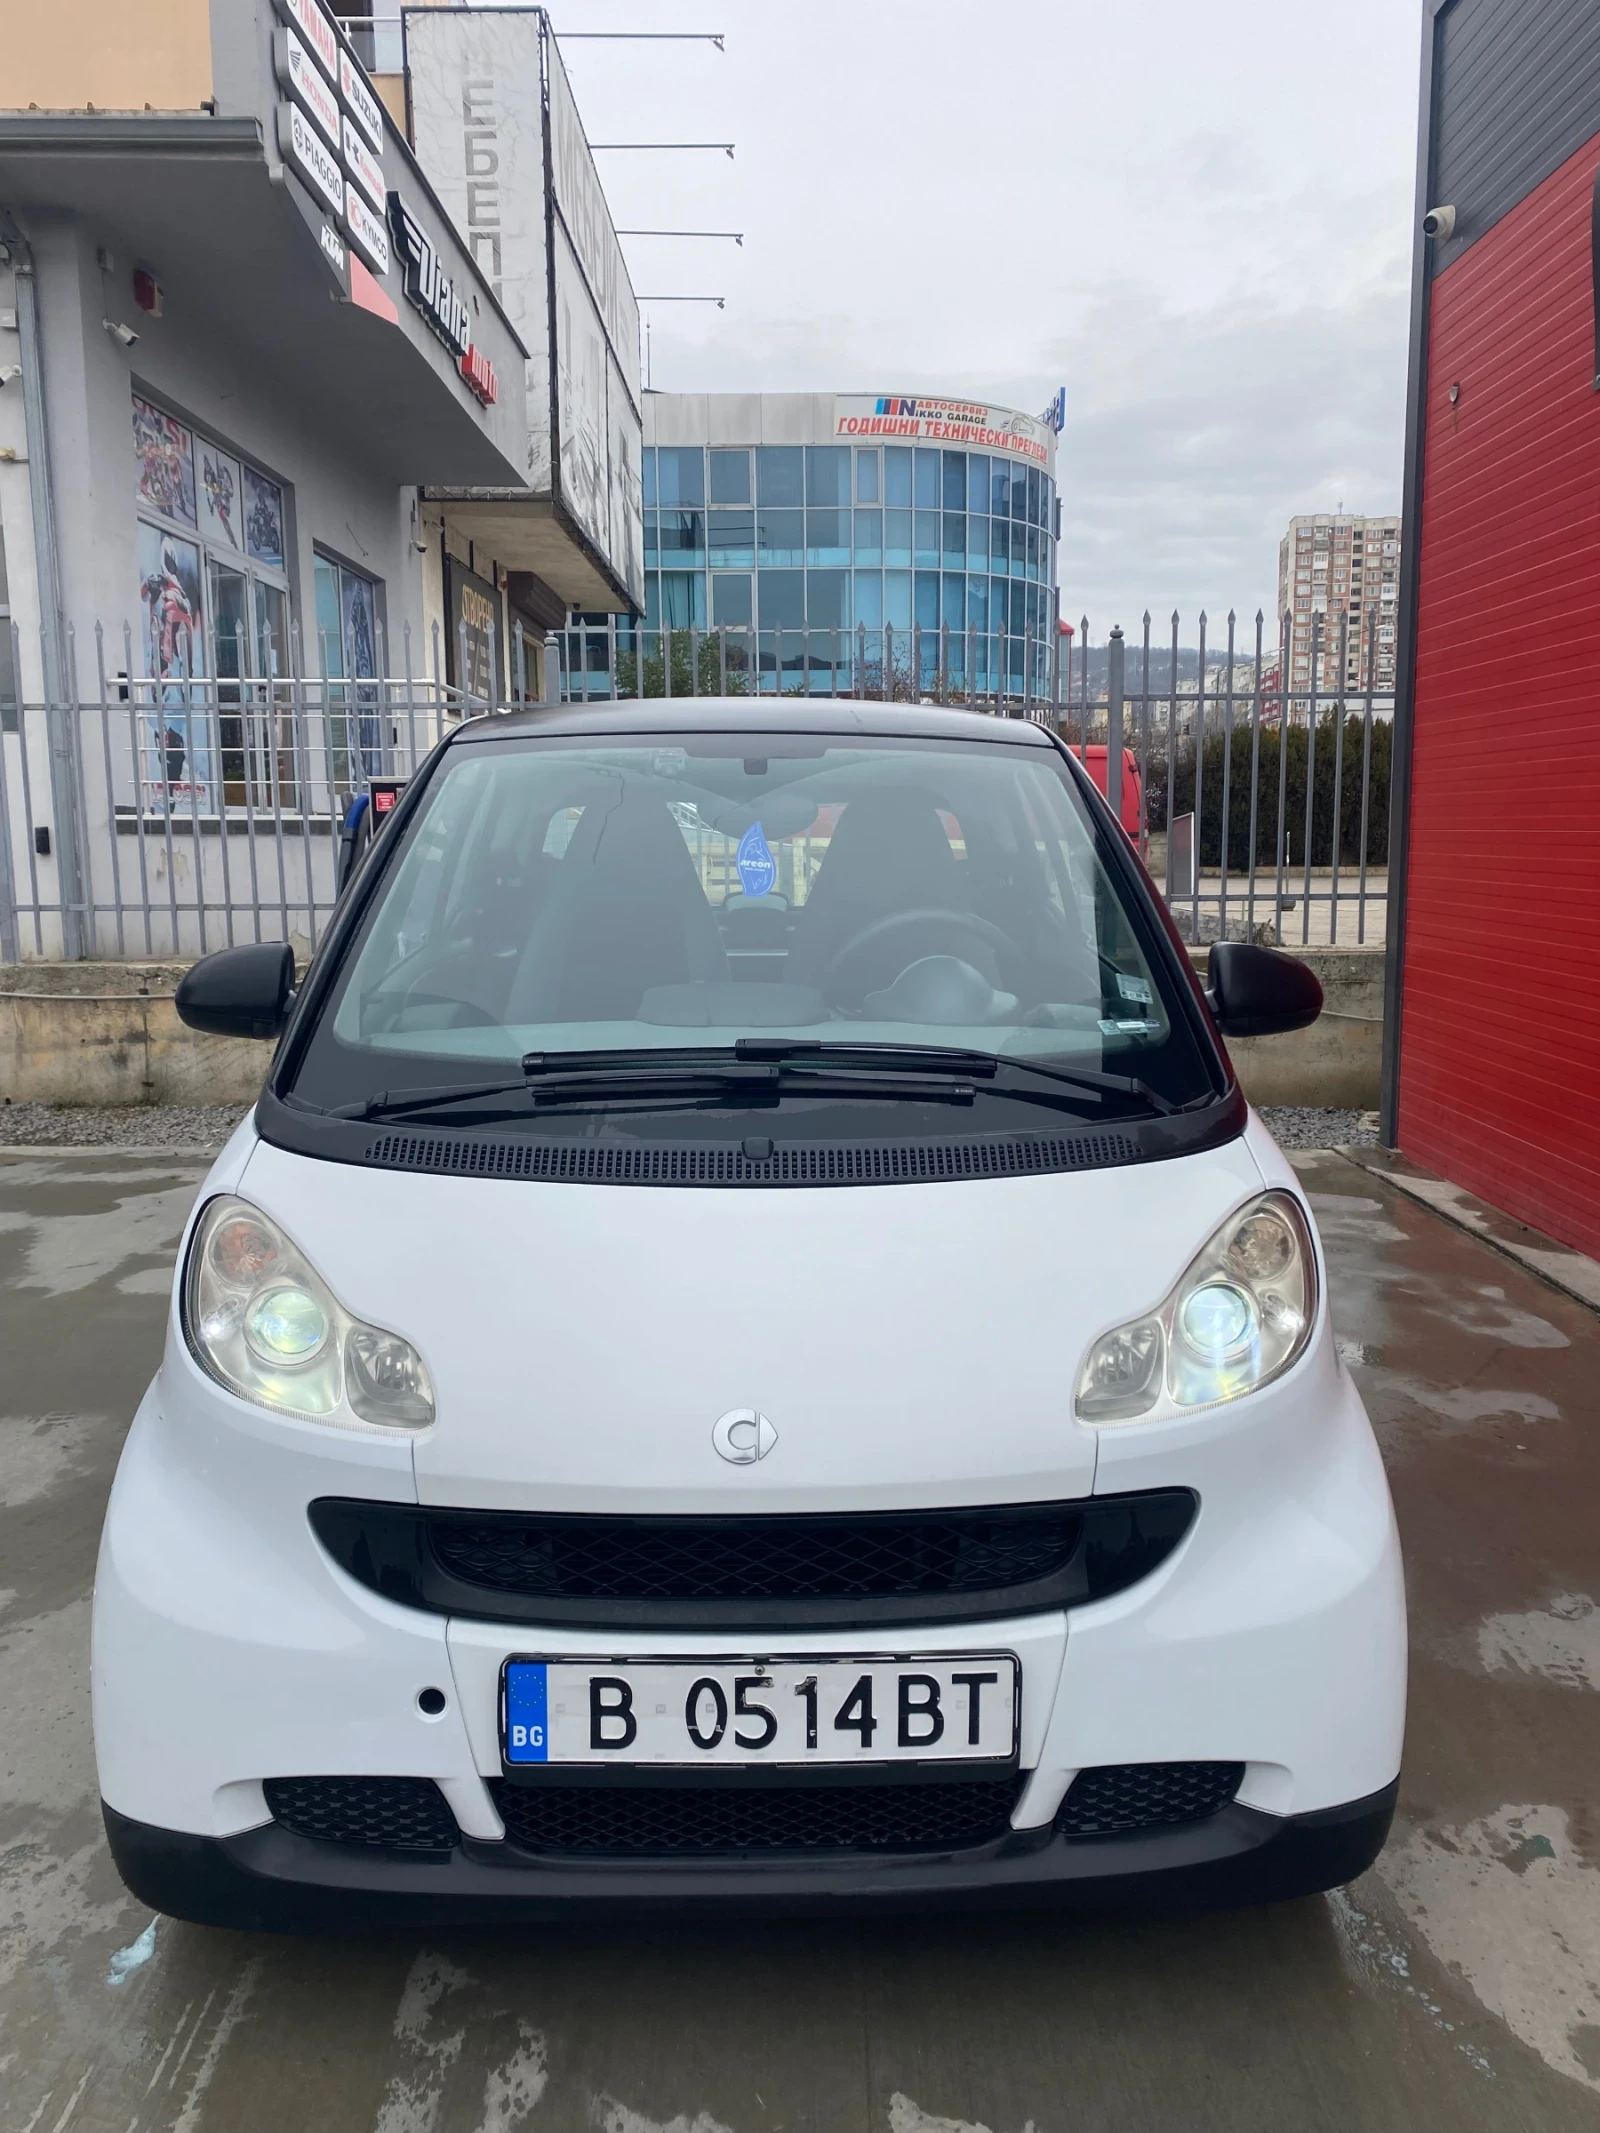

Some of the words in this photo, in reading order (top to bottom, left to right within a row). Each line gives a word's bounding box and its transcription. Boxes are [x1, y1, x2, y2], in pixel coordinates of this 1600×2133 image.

[301, 67, 338, 136] HONDA
[351, 79, 382, 142] SUZUKI
[304, 132, 342, 200] PIAGGIO
[320, 224, 344, 271] KTM
[361, 215, 387, 261] KYMCO
[408, 212, 471, 356] Diana
[917, 400, 989, 417] АВТОСЕРВИЗ
[947, 412, 988, 426] GARAGE
[837, 416, 921, 436] ГОДИШНИ
[924, 420, 1010, 448] ТЕХНИЧЕСКИ
[1011, 433, 1049, 463] ПРЕГЛЕДИ
[739, 859, 772, 869] areon
[513, 1725, 543, 1747] BG
